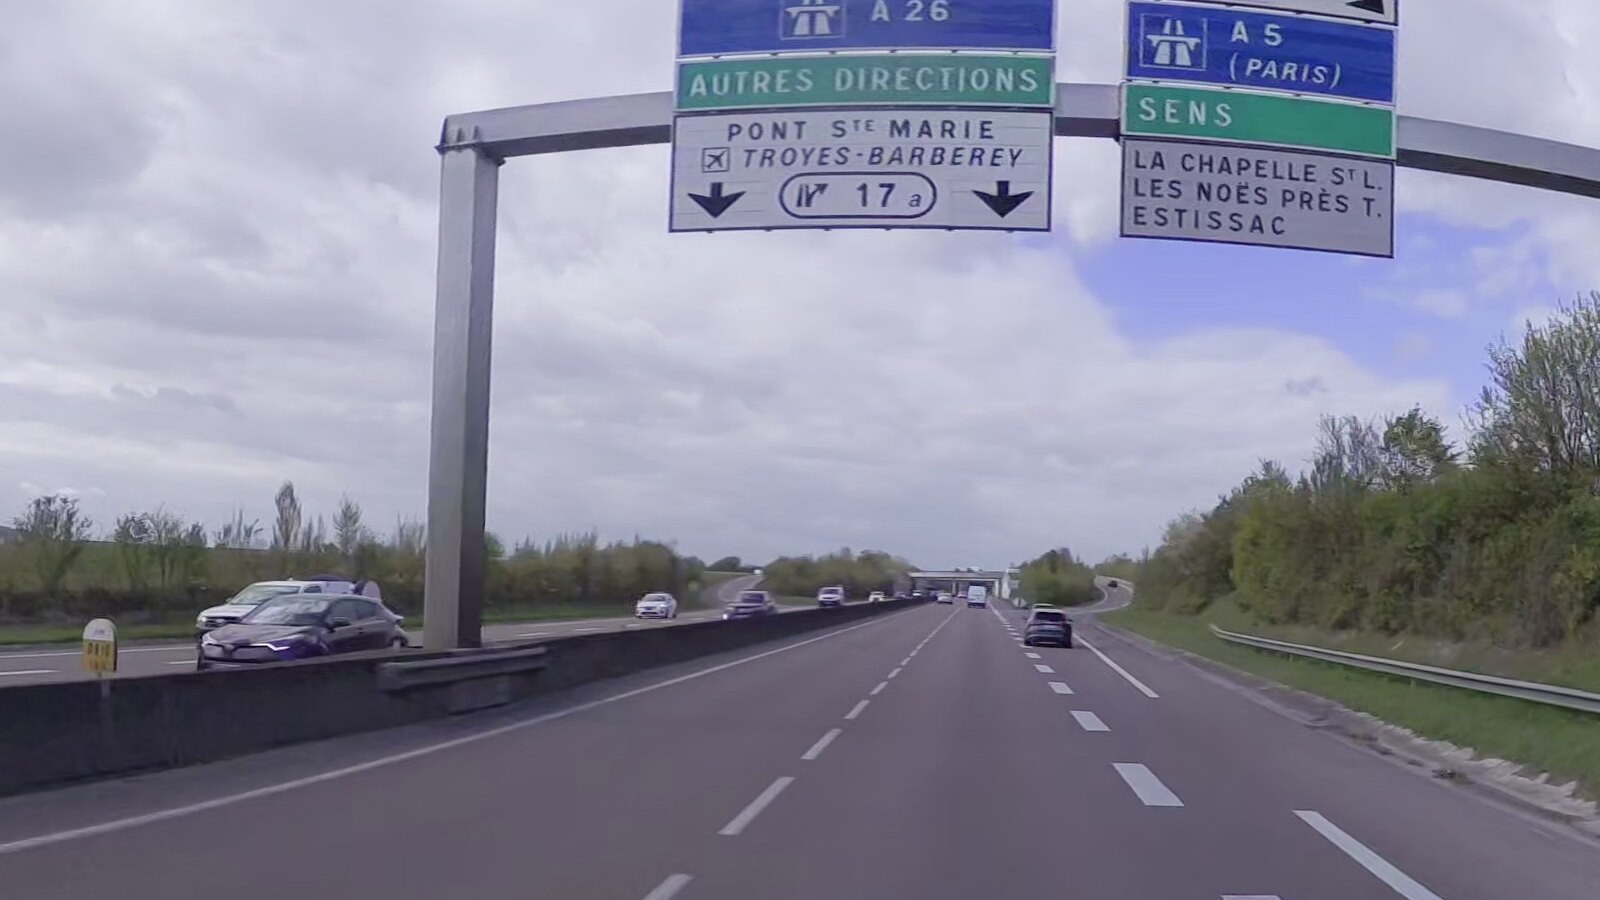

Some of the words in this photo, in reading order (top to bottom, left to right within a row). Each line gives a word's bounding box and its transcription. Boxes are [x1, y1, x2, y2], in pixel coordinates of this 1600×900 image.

[871, 0, 891, 22] A
[904, 0, 950, 22] 26
[1231, 20, 1249, 44] A
[1263, 23, 1283, 47] 5
[689, 68, 813, 97] AUTRES
[834, 67, 1039, 93] DIRECTIONS
[1229, 52, 1342, 90] (PARIS)
[1139, 97, 1233, 127] SENS
[727, 121, 807, 142] PONT
[889, 119, 995, 140] MARIE
[744, 146, 1023, 168] TROYES-BARBEREY
[1134, 150, 1166, 171] LA
[1181, 153, 1317, 183] CHAPELLE
[1363, 171, 1383, 191] L.
[856, 182, 897, 208] 17
[908, 194, 923, 208] a
[1133, 177, 1183, 201] LES
[1197, 181, 1268, 206] NOËS
[1281, 188, 1350, 214] PRÈS
[1363, 197, 1383, 218] T.
[1133, 206, 1286, 236] ESTISSAC
